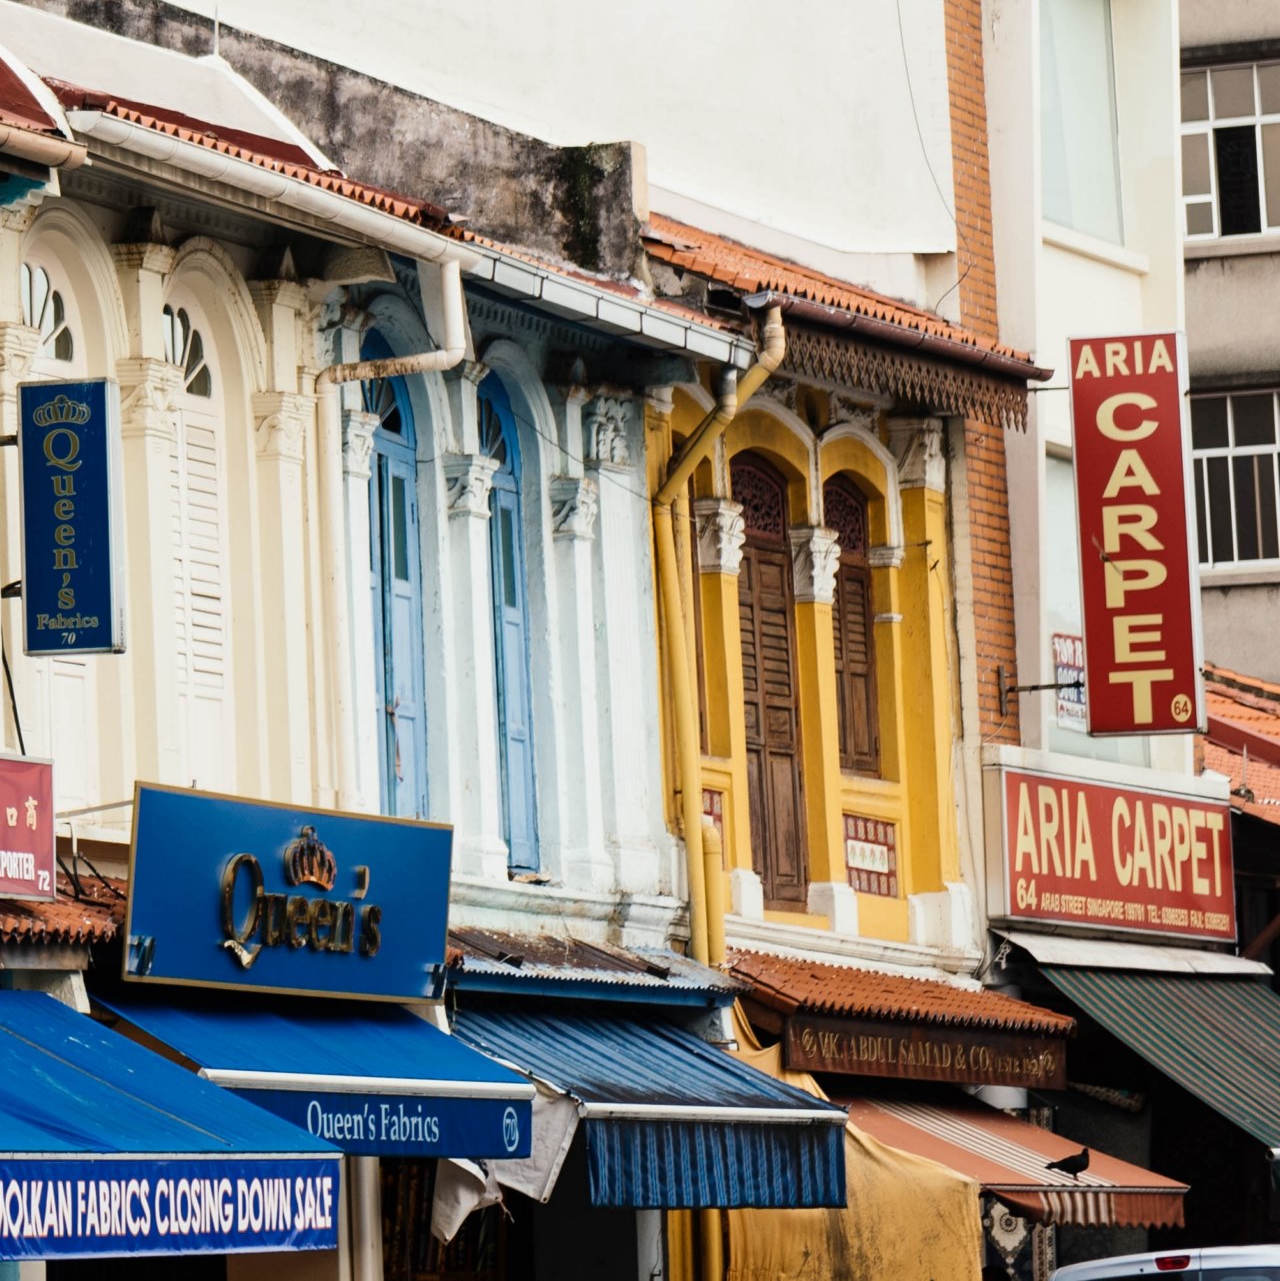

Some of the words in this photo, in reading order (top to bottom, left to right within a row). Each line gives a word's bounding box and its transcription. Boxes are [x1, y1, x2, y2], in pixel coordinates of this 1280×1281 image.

[1075, 339, 1174, 379] ARIA
[43, 428, 82, 610] Queen's
[1096, 392, 1174, 725] CARPET
[36, 613, 99, 630] Fabrics
[61, 631, 76, 645] 70
[1173, 700, 1189, 716] 64
[1015, 782, 1097, 881] ARIA
[1111, 796, 1224, 897] CARPET
[37, 870, 51, 891] 72
[1016, 878, 1037, 910] 64
[1041, 892, 1060, 913] ARAB
[1060, 894, 1086, 916] STREET
[1086, 898, 1125, 920] SINGAPORE
[218, 852, 383, 969] Queen's
[848, 1034, 897, 1063] ABDUL
[899, 1038, 952, 1068] SAMAD
[955, 1044, 967, 1070] &
[380, 1103, 440, 1143] Fabrics
[77, 1178, 151, 1237] FABRICS
[155, 1178, 234, 1235] CLOSING
[237, 1177, 291, 1233] DOWN
[294, 1176, 332, 1230] SALE
